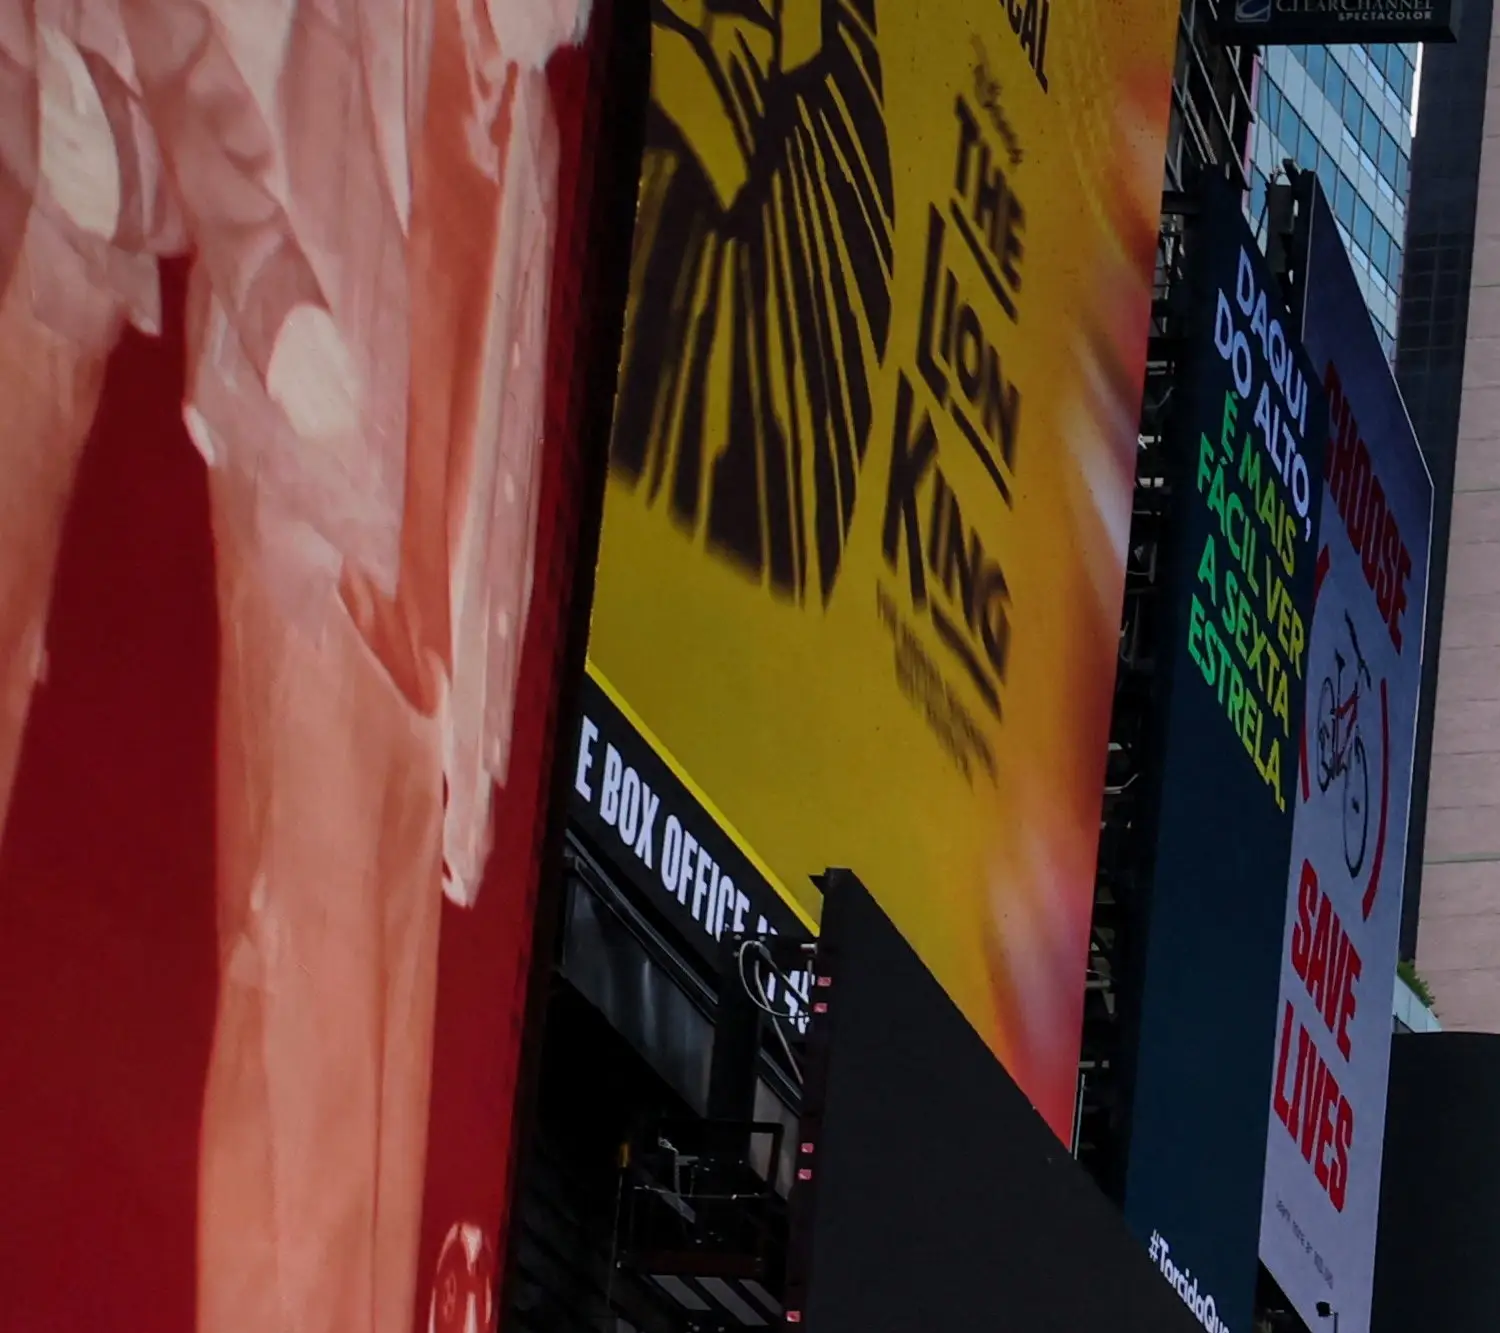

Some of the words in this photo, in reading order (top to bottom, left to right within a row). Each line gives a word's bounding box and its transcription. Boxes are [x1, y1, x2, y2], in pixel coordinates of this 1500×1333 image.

[955, 92, 1026, 294] THE
[916, 200, 1021, 478] LION
[1214, 287, 1253, 399] DO
[1253, 381, 1313, 543] ALTO,
[1236, 244, 1308, 438] DAQUI
[882, 366, 1013, 688] KING
[1198, 428, 1259, 598] FÁCIL
[1265, 554, 1305, 681] VER
[1239, 431, 1297, 578] MAIS
[1325, 359, 1412, 656] CHOOSE
[1197, 534, 1217, 606] A
[1222, 567, 1290, 738] SEXTA
[600, 742, 660, 870] BOX
[661, 814, 751, 943] OFFICE
[1290, 857, 1362, 1064] SAVE
[1273, 999, 1354, 1213] LIVES
